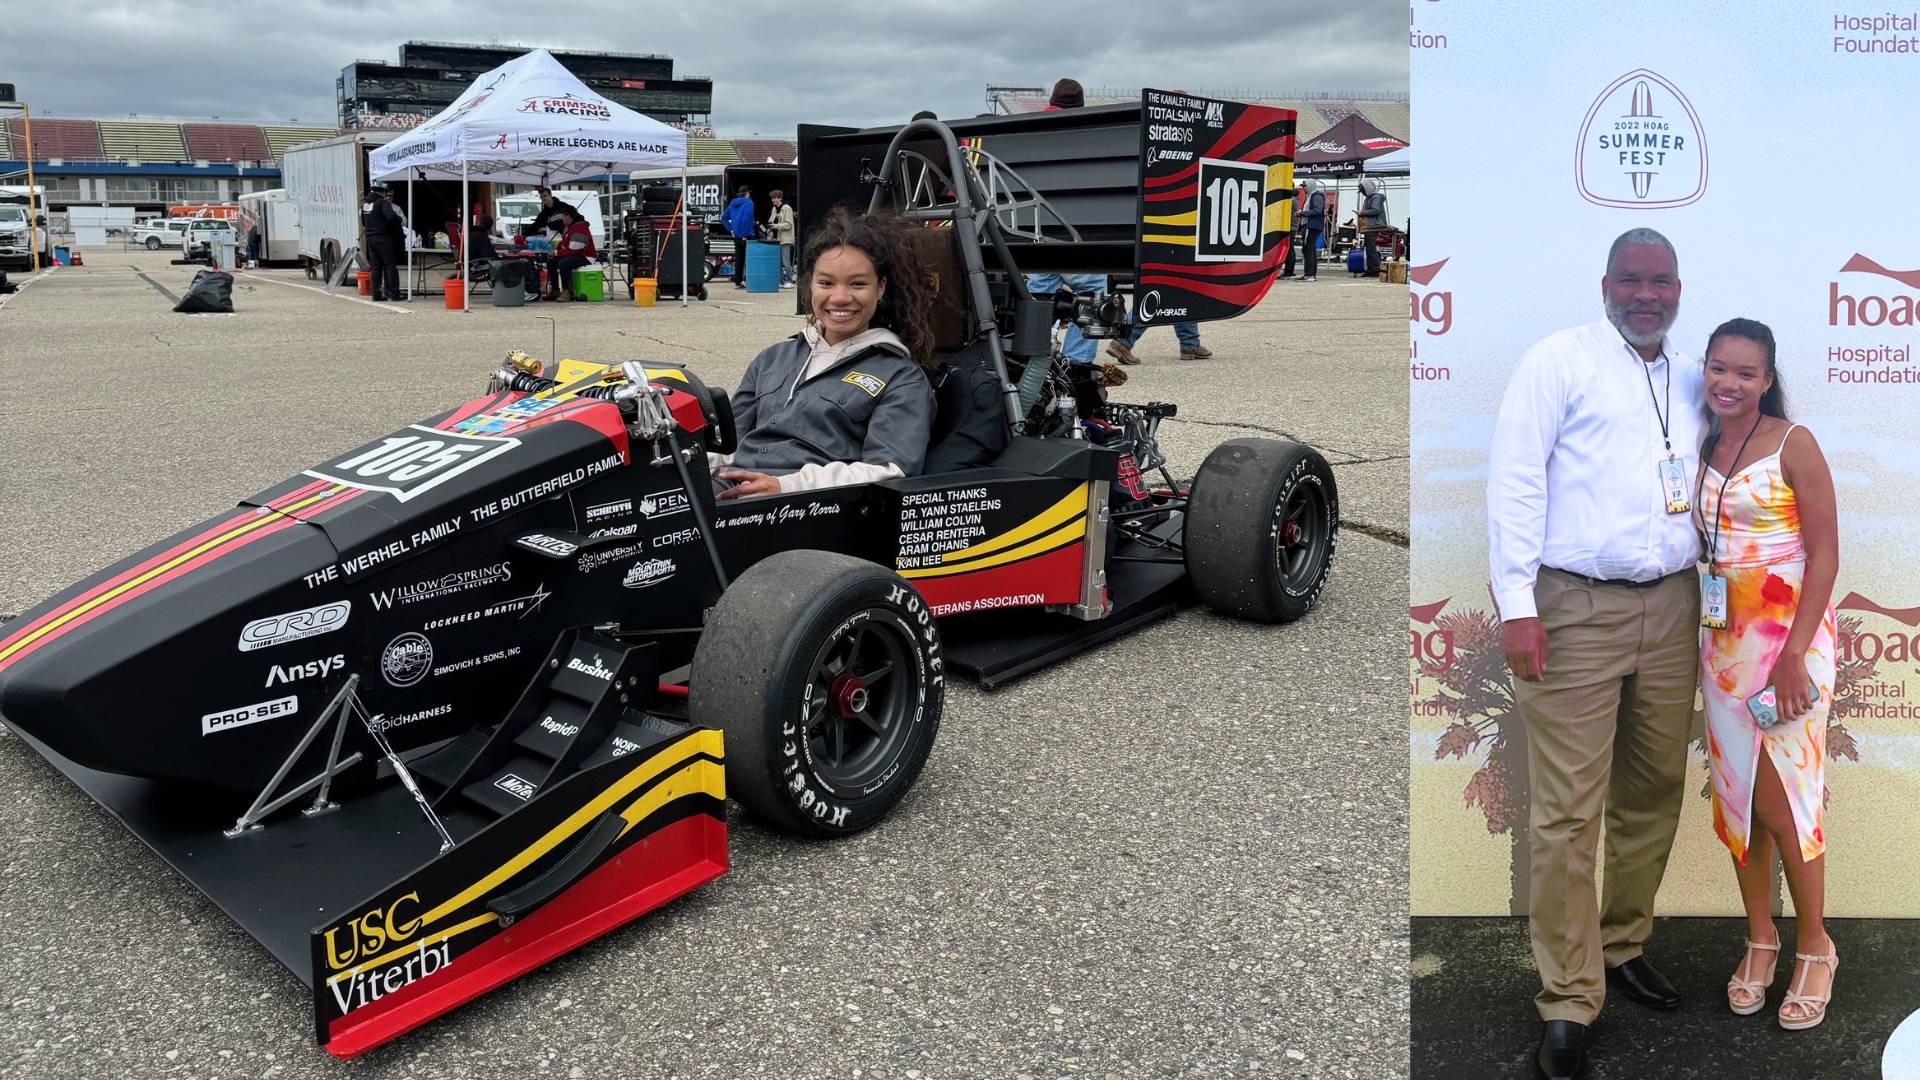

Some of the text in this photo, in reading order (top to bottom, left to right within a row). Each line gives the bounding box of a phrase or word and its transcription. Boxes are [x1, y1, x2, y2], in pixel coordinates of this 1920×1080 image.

[1834, 12, 1917, 35] Hospital
[543, 100, 608, 110] CRIMSON
[1148, 92, 1206, 110] THE KANALEY FAMILY
[544, 107, 611, 117] RACING
[1148, 106, 1194, 123] TOTALSIM
[1149, 123, 1193, 145] stratasys
[1615, 122, 1670, 131] 2022 HOAG
[528, 137, 668, 154] WHERE LEGENDS ARE MADE
[1599, 133, 1685, 150] SUMMER
[1159, 149, 1193, 160] BOEING
[1620, 151, 1666, 166] FEST
[1328, 163, 1343, 171] Sports
[1206, 177, 1258, 246] 105
[1155, 308, 1187, 317] VI-GRADE
[1828, 344, 1909, 366] Hospital
[1828, 366, 1920, 383] Foundati
[334, 436, 484, 481] 105
[902, 487, 987, 506] SPECIAL THANKS
[586, 502, 632, 518] SCHROTH
[587, 511, 633, 523] RACING
[715, 501, 840, 529] in memory of Gary Norris
[901, 499, 1001, 520] DR. YANN STAELENS
[304, 450, 625, 589] THE WERHEL FAMILY THE BUTTERFIELD FAMILY
[901, 514, 981, 532] WILLIAM COLVIN
[899, 526, 986, 545] CESAR RENTERIA
[596, 541, 643, 561] UNIVERSITY
[899, 539, 969, 557] ARAM OHANIS
[628, 559, 671, 577] MOUNTAIN
[898, 554, 942, 569] KAN LEE
[623, 564, 677, 584] MOTORSPORTS
[370, 561, 512, 611] WILLOW SPRINGS
[401, 578, 498, 605] INTERNATIONAL RACEWAY
[931, 593, 1045, 616] TERANS ASSOCIATION
[243, 604, 348, 642] CRD
[424, 601, 525, 631] LOCKHEED MARTIN
[272, 627, 323, 644] MANUFACTURING
[391, 642, 424, 659] Cable
[434, 646, 521, 676] SIMOVICH & SONS, INC
[265, 654, 345, 688] Ansys
[1838, 681, 1905, 700] ospital
[1838, 701, 1920, 719] oundati
[324, 891, 420, 970] USC
[326, 935, 453, 1016] Viterbi
